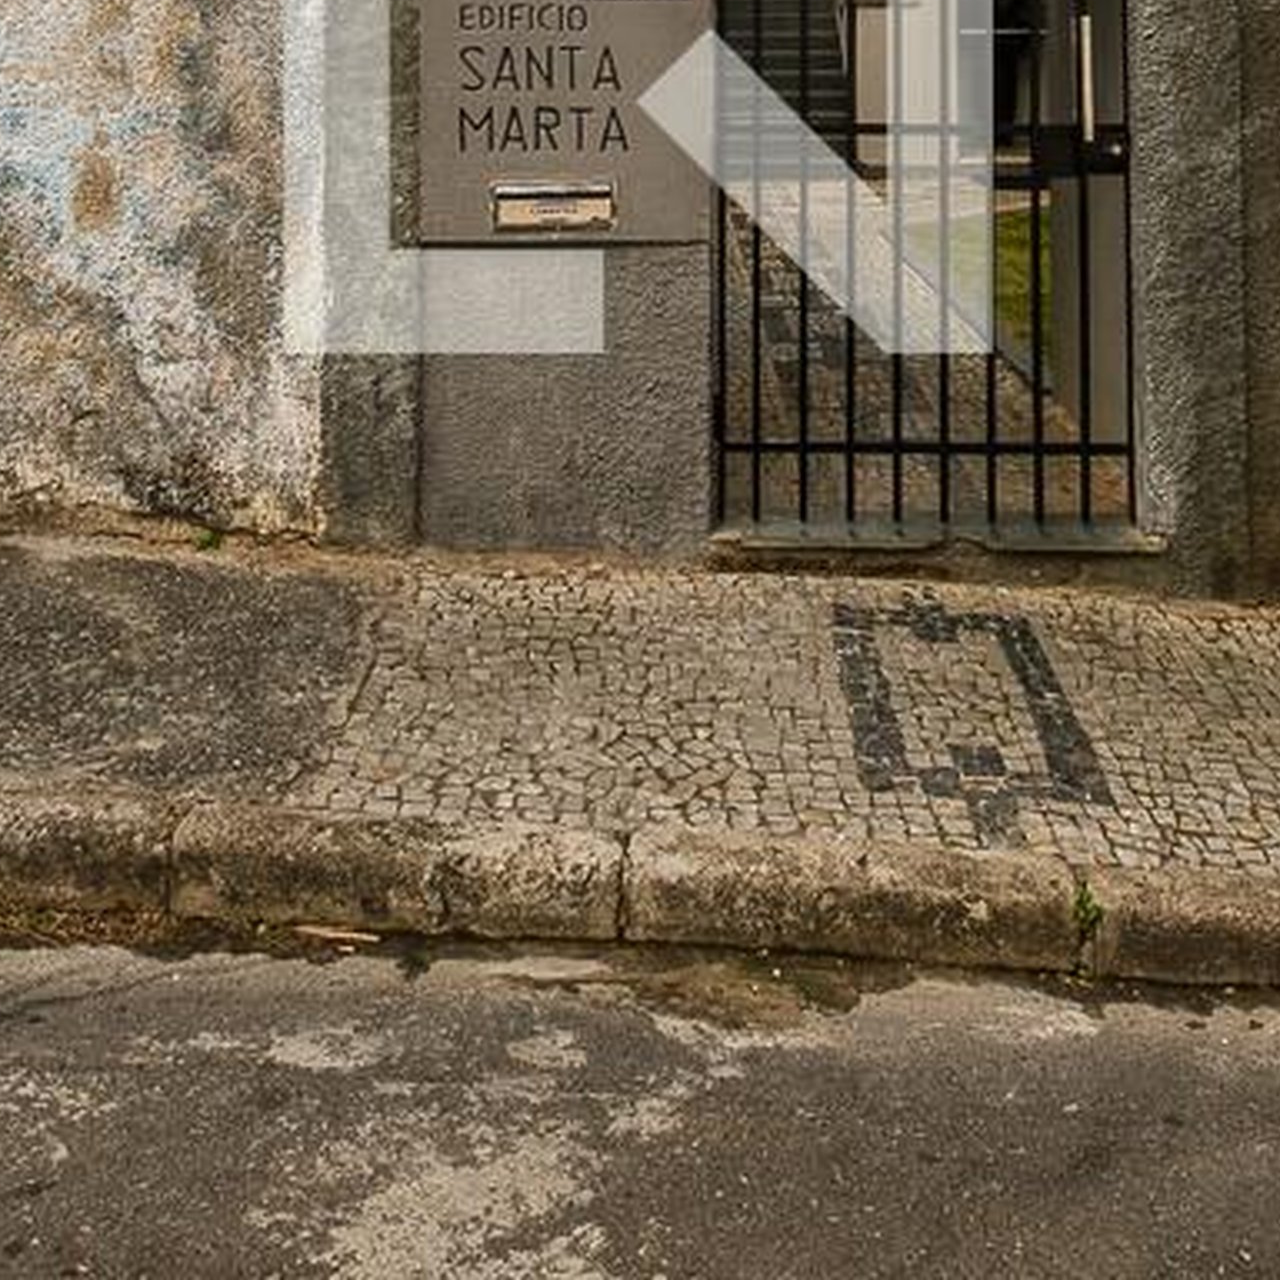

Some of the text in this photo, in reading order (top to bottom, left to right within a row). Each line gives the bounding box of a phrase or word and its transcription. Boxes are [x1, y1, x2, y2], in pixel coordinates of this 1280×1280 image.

[459, 4, 588, 31] EDIFICIO
[459, 46, 622, 91] SANTA
[459, 107, 629, 152] MARTA
